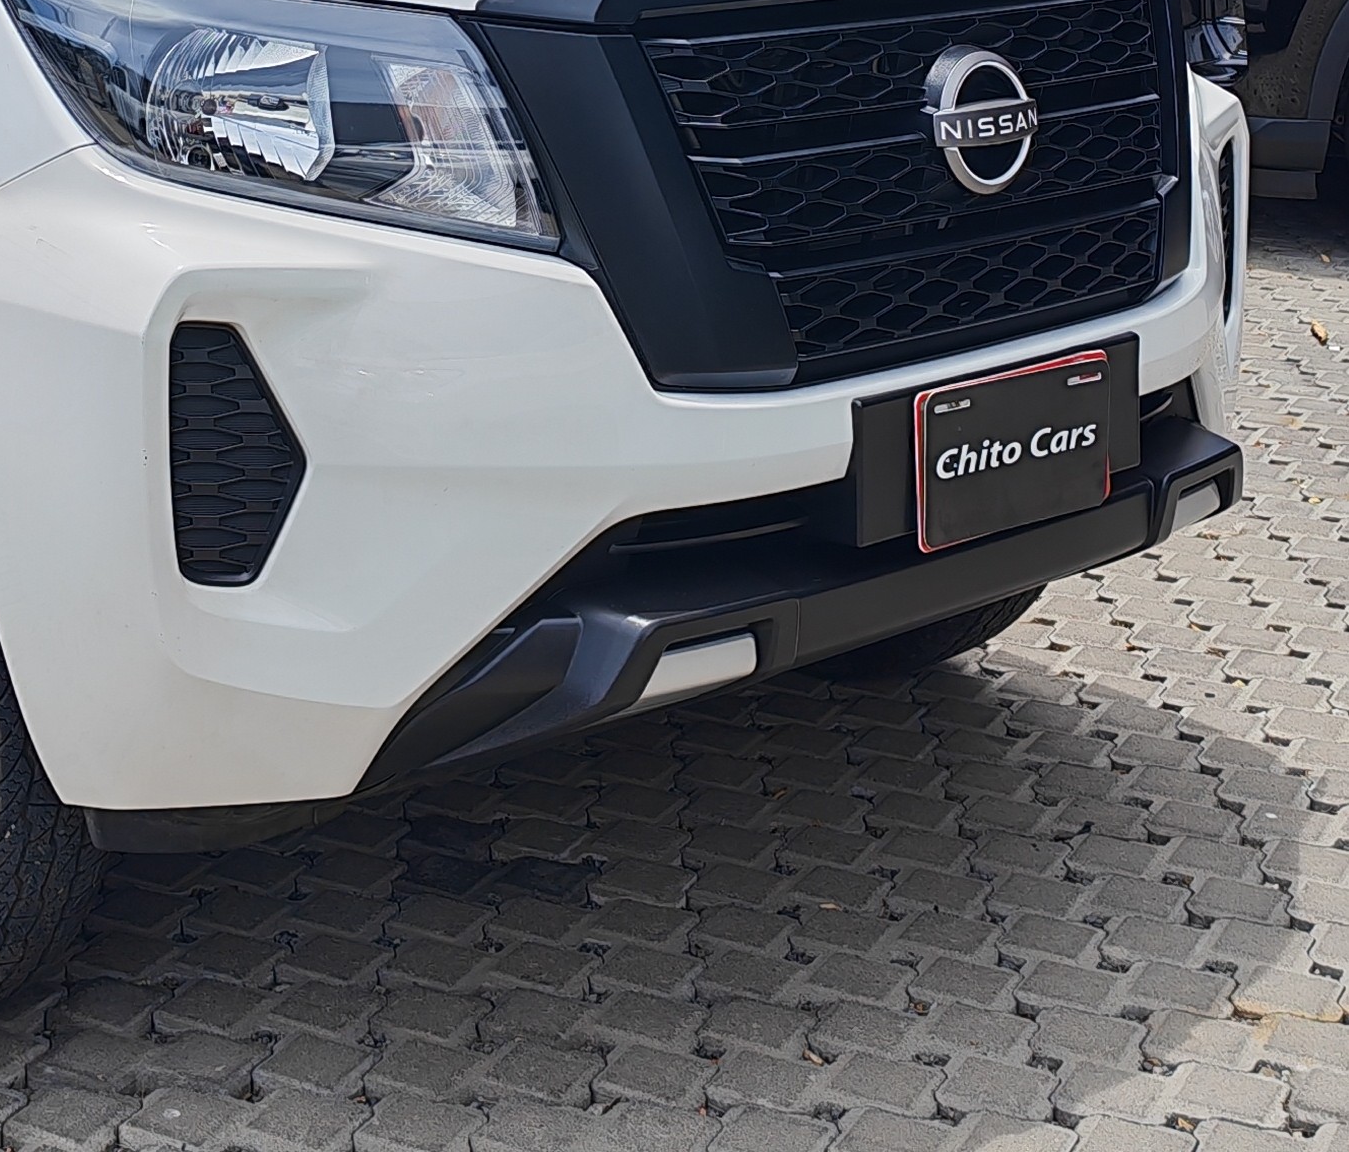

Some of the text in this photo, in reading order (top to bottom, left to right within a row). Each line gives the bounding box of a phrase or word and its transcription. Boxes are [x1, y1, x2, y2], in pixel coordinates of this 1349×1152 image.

[940, 107, 1038, 141] NISSAN
[935, 423, 1097, 480] Chito Cars
